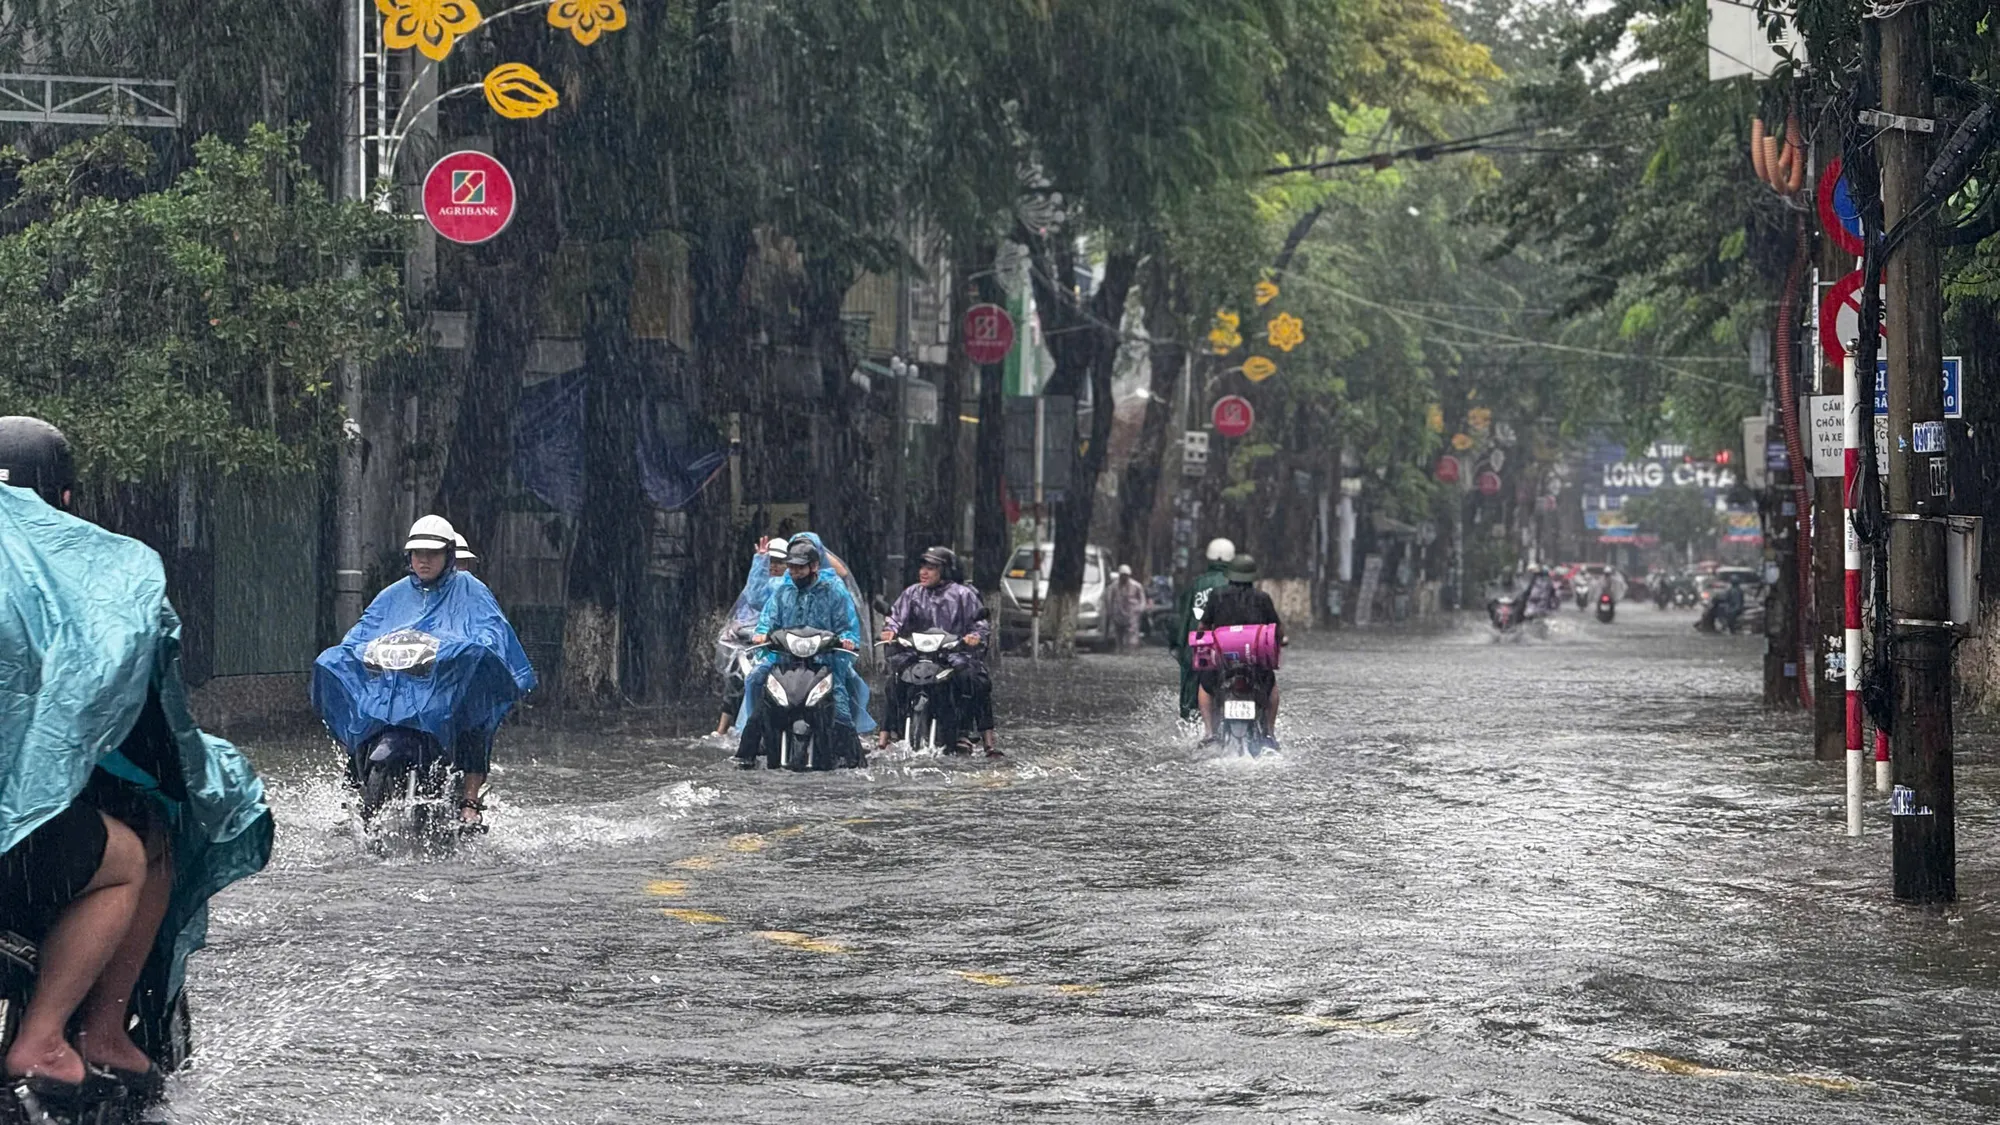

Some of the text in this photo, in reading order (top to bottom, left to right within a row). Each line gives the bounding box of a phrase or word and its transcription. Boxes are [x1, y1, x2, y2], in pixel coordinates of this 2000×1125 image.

[438, 206, 498, 216] AGRIBANK
[1823, 399, 1840, 411] CẤM
[1818, 432, 1830, 443] VÀ
[1832, 432, 1843, 442] XE
[1603, 462, 1736, 487] LONG CHA
